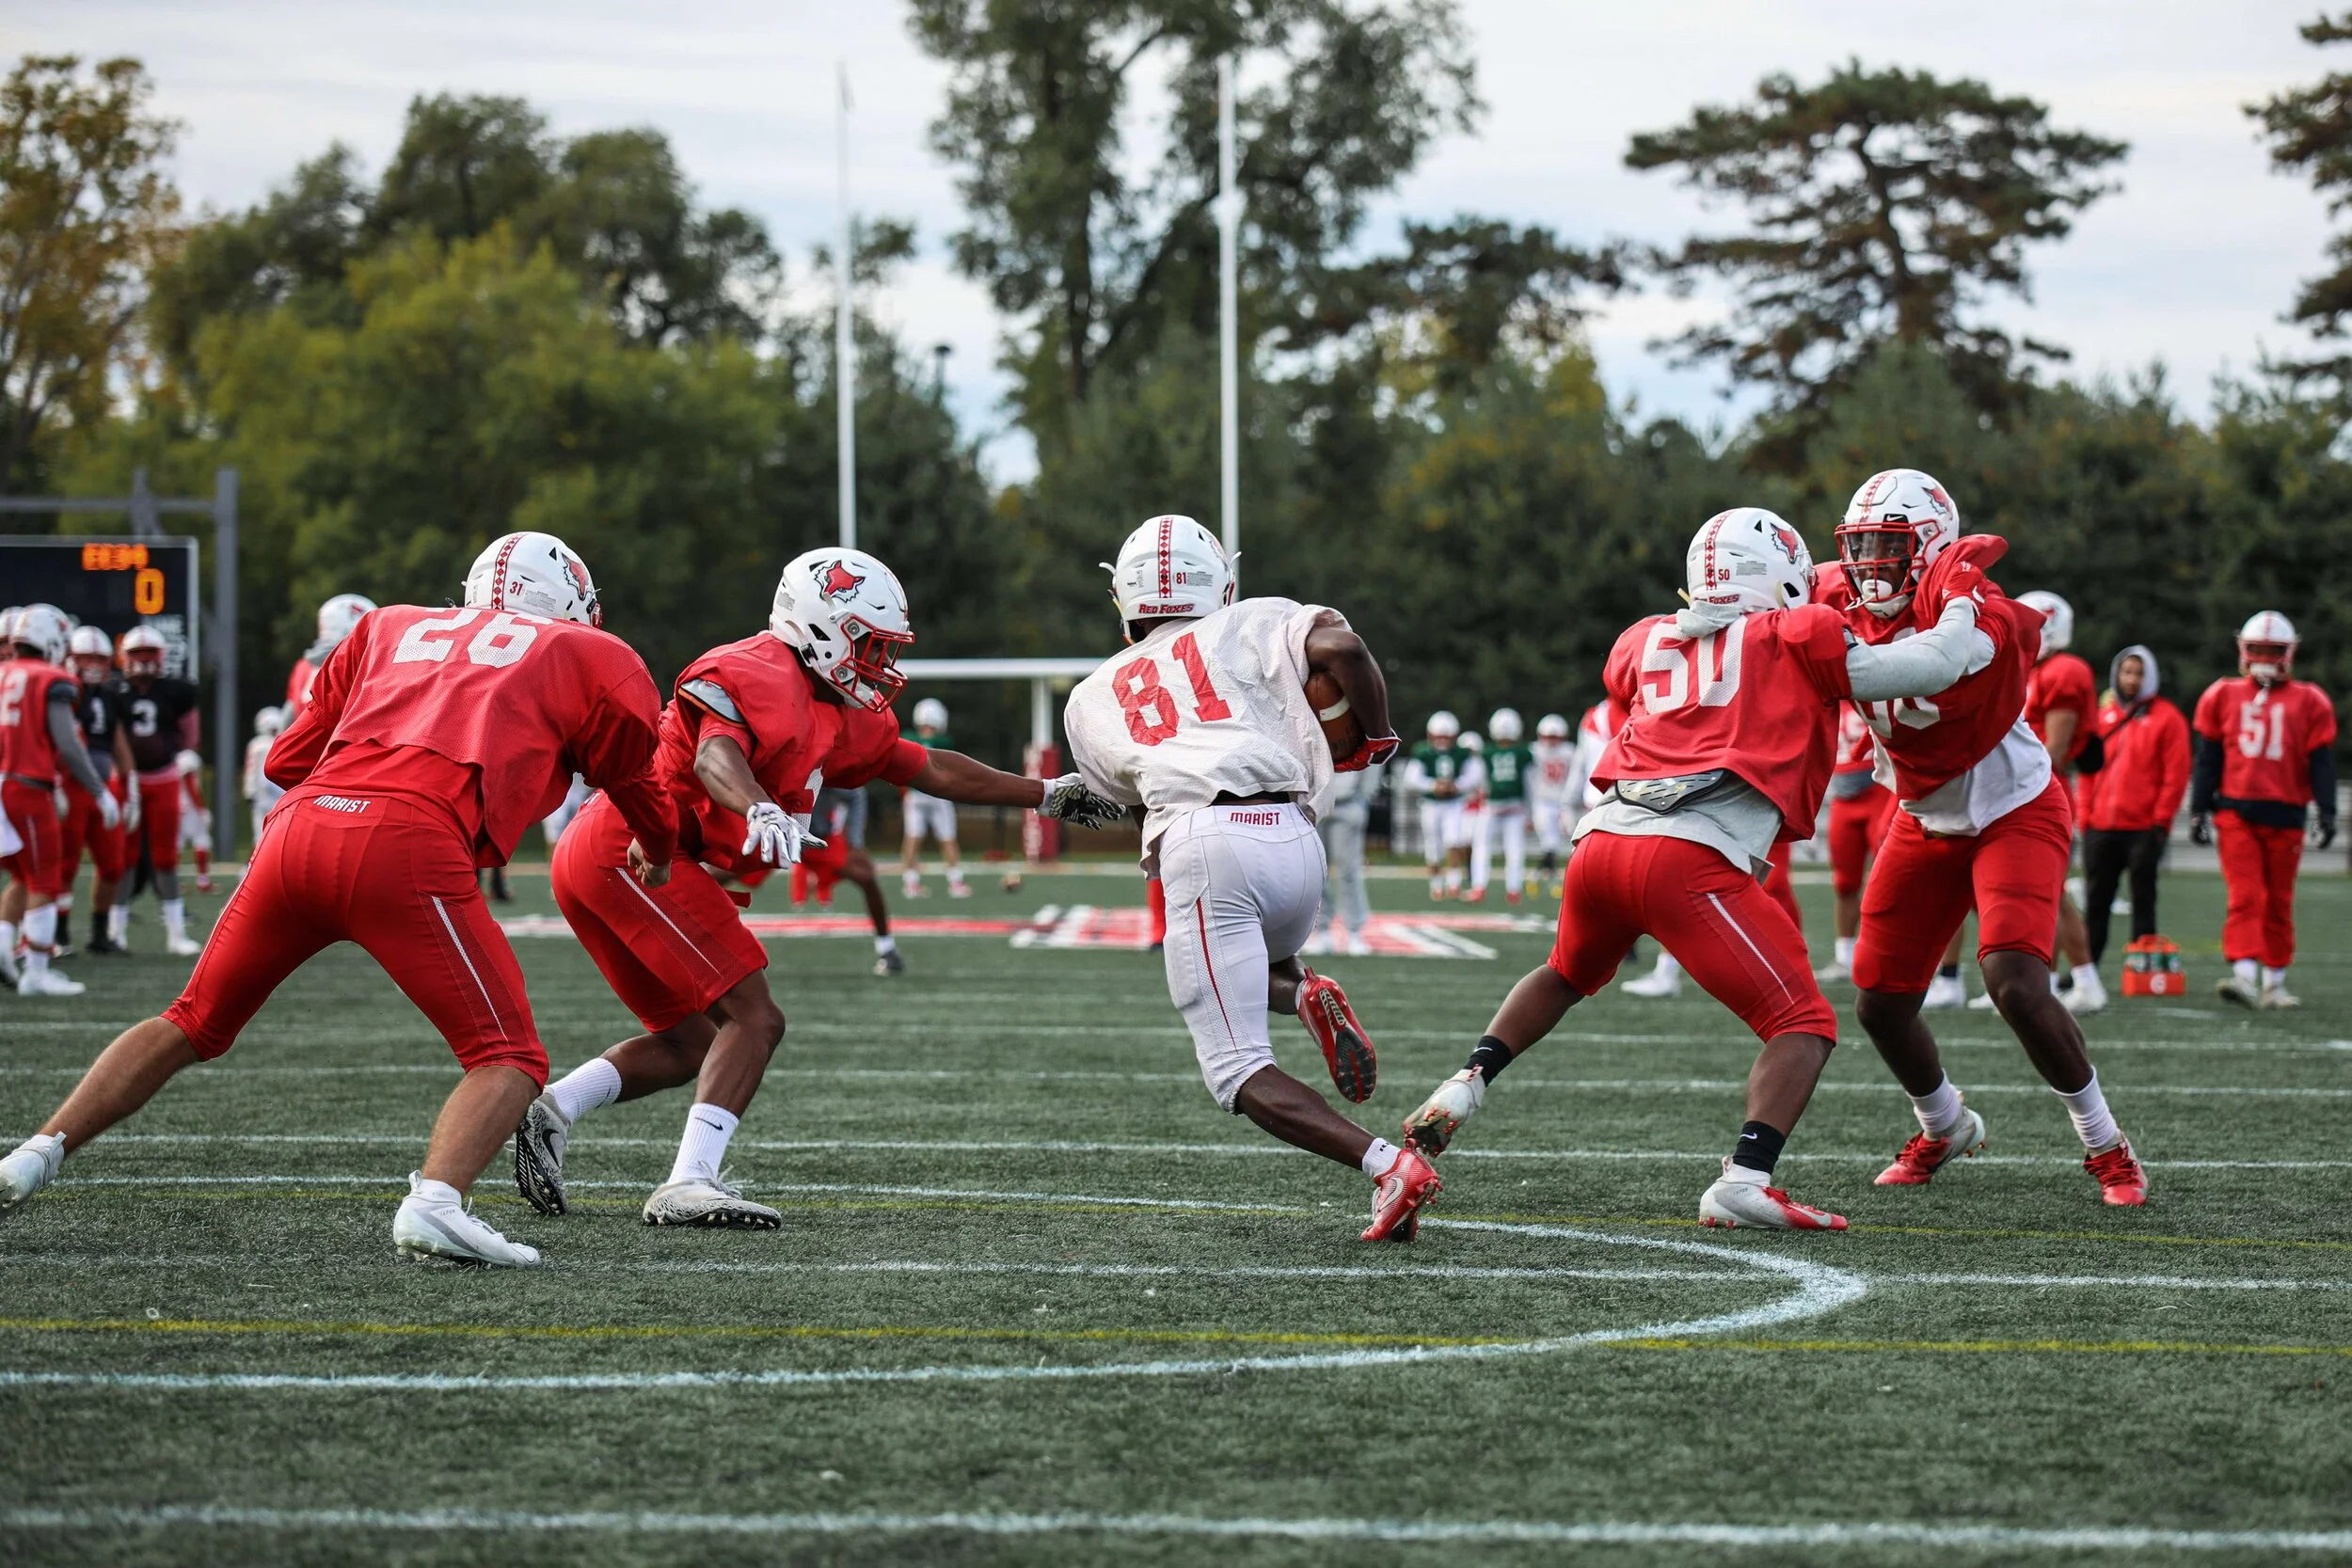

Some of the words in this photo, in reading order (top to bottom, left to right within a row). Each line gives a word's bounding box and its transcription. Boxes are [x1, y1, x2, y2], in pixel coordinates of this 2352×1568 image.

[135, 568, 165, 614] 0
[509, 581, 524, 596] 31
[1176, 572, 1187, 584] 81
[1718, 568, 1730, 580] 50
[392, 609, 555, 669] 26
[1641, 614, 1748, 715] 50
[1112, 631, 1232, 746] 81
[132, 699, 158, 737] 3
[2238, 701, 2285, 761] 51
[312, 795, 372, 814] MARIST
[1230, 812, 1280, 826] MARIST
